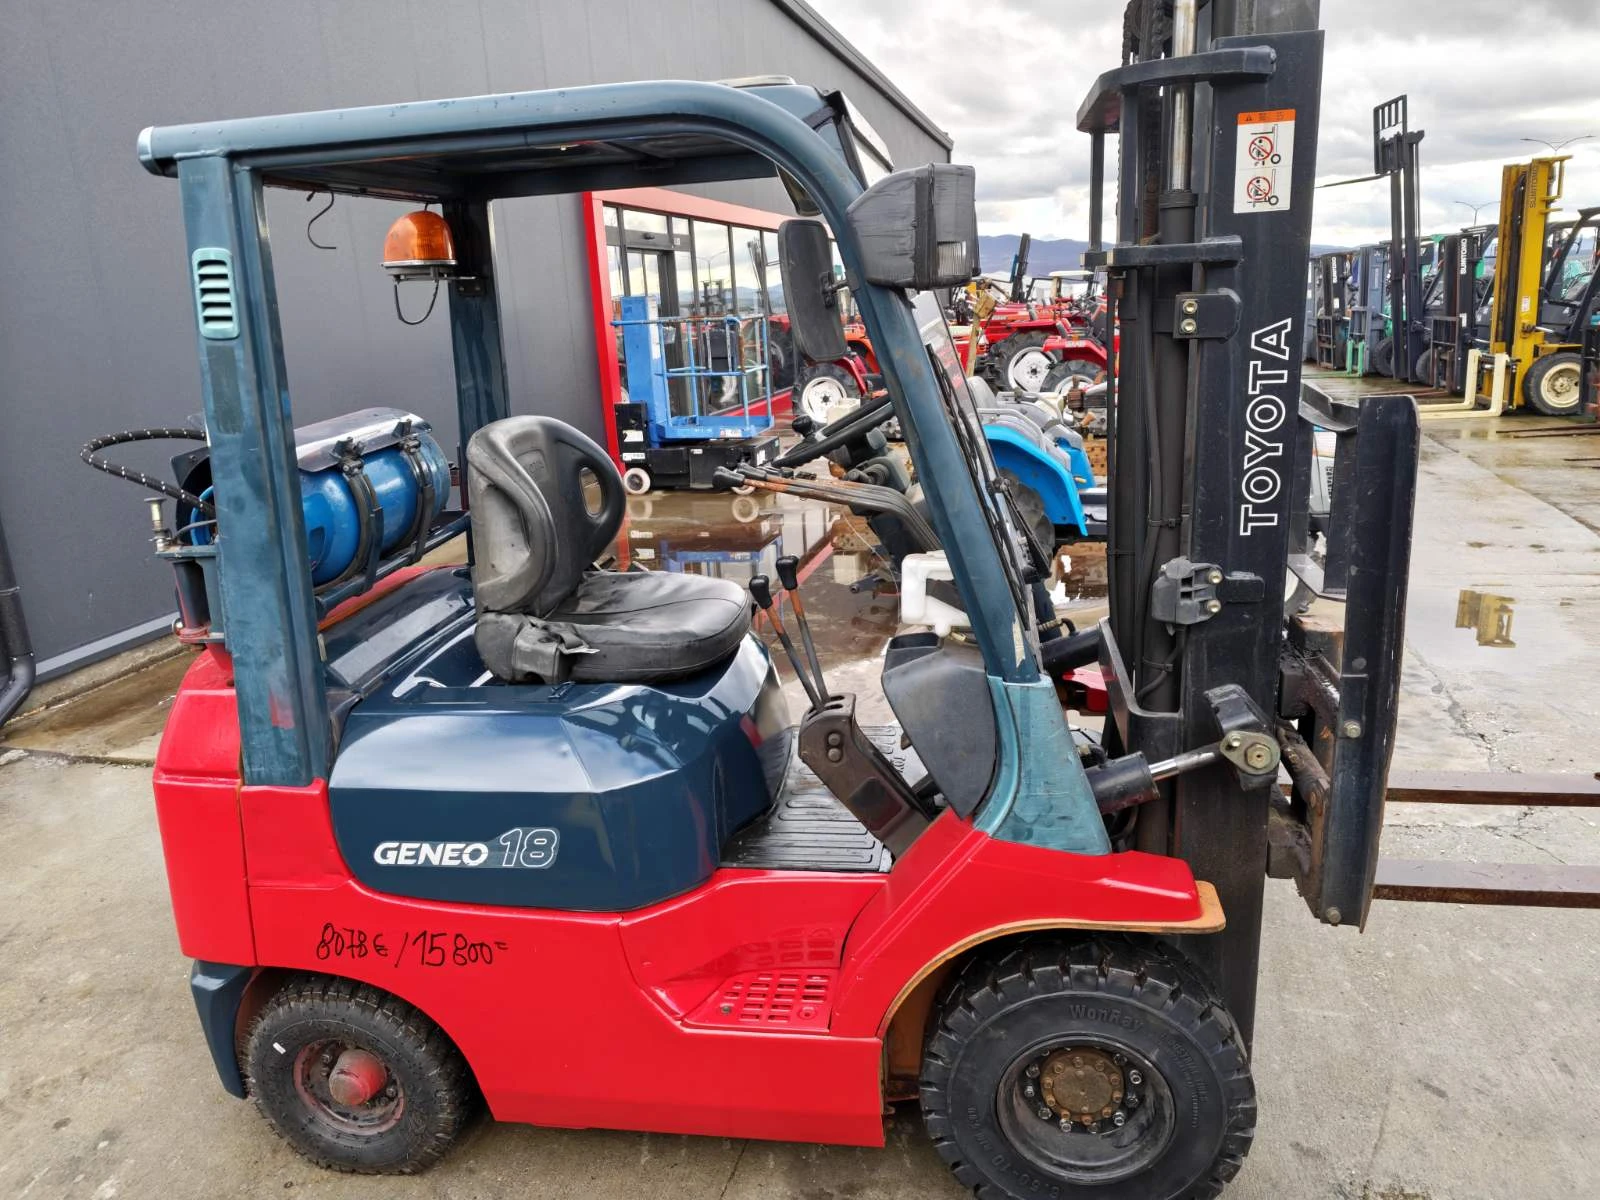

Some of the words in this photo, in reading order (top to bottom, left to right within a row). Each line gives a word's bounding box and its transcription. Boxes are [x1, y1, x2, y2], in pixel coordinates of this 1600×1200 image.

[1239, 317, 1292, 536] TOYOTA
[373, 842, 489, 867] GENEO
[499, 828, 558, 868] 18
[1069, 1003, 1145, 1033] WonRay
